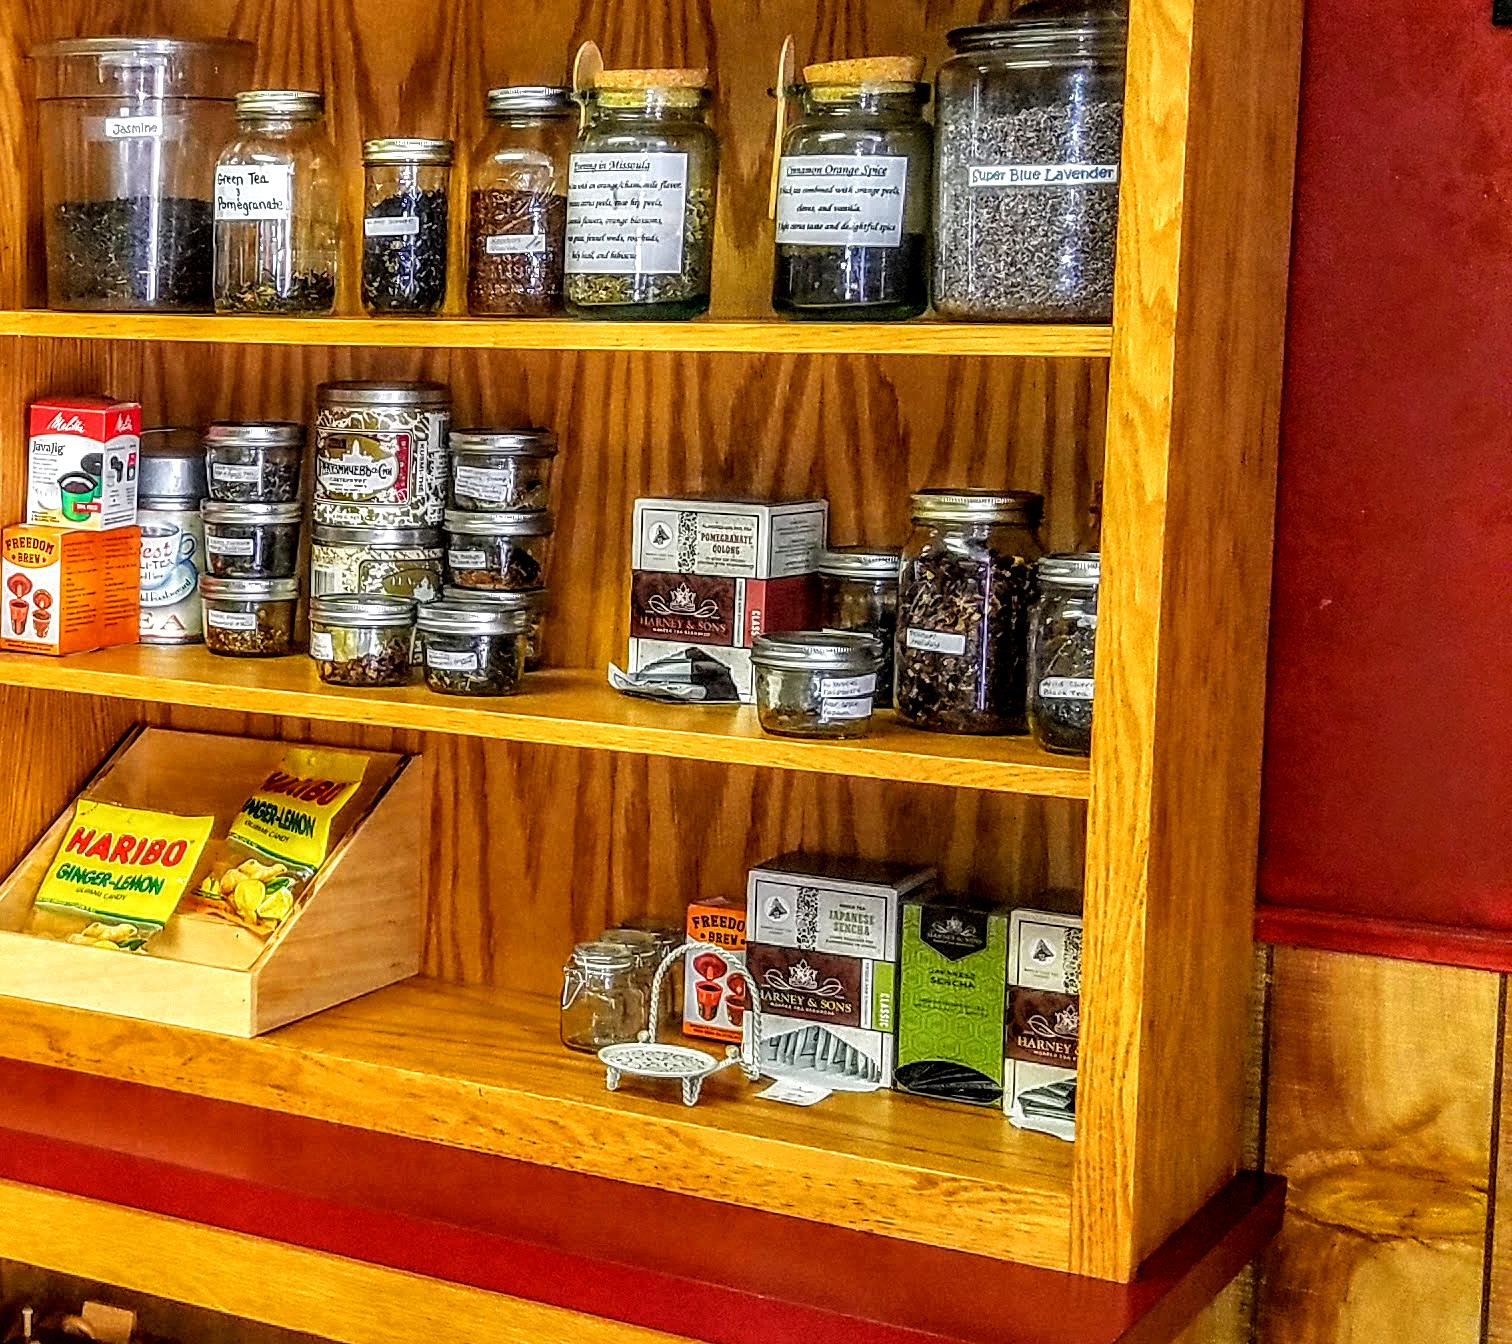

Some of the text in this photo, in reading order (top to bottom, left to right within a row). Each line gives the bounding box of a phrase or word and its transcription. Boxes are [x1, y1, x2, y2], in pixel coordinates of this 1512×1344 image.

[112, 120, 159, 135] Jasmine
[217, 172, 270, 186] Green Tea
[824, 164, 860, 177] Orange
[971, 166, 1115, 185] Super Blue Lavender
[217, 196, 284, 217] Pomegranate
[4, 536, 55, 556] FREEDOM
[699, 532, 754, 545] POMEGRANATE
[17, 552, 41, 564] BREW
[140, 542, 173, 559] est
[139, 612, 186, 631] EA
[639, 614, 683, 629] HARNEY
[697, 619, 727, 633] SONS
[751, 610, 761, 637] CLASS
[65, 826, 188, 867] HARIBO
[56, 862, 166, 895] GINGER-LEMON
[691, 915, 746, 933] FREEDO
[828, 910, 876, 926] JAPANESE
[708, 931, 738, 946] BREW
[833, 922, 870, 937] SENCHA
[760, 990, 853, 1014] HARNEY & SONS
[879, 992, 891, 1028] CLASSIC
[1017, 1035, 1071, 1055] HARNEY
